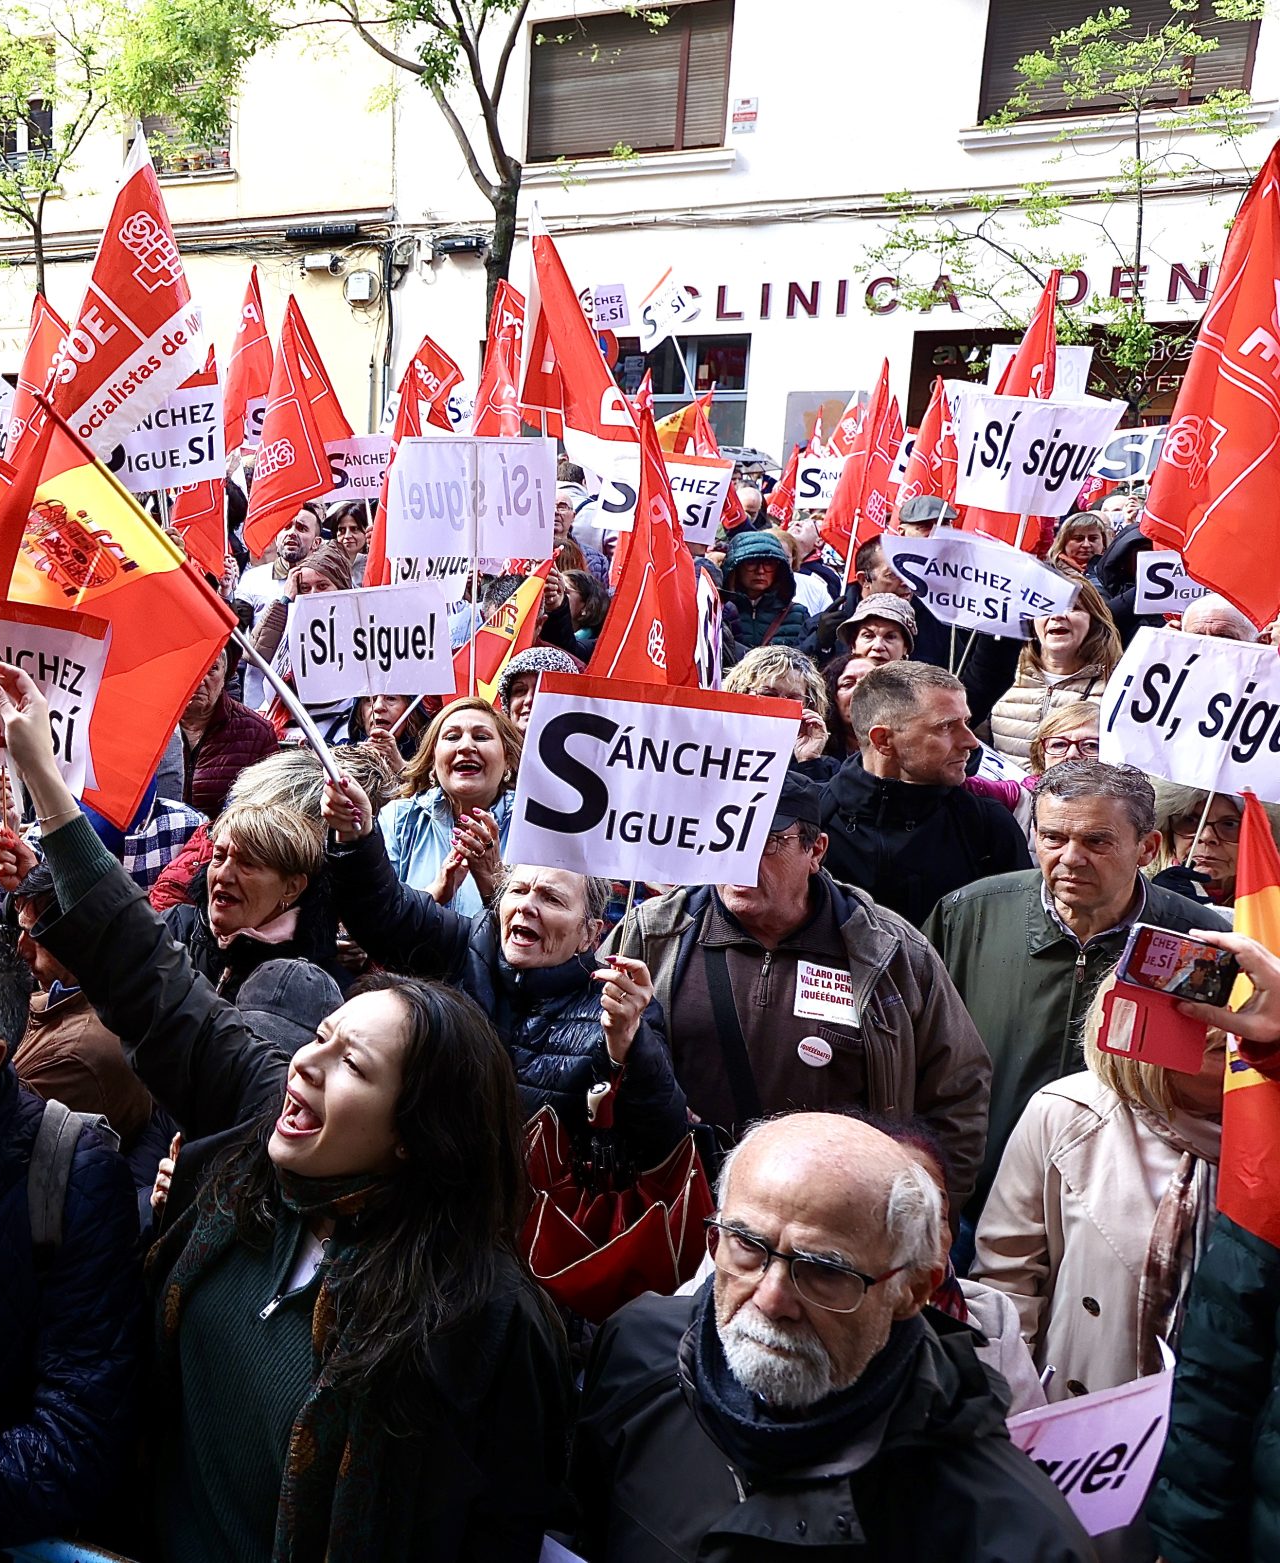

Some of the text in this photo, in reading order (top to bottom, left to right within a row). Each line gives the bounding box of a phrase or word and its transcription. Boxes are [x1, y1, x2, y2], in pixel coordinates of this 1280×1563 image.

[79, 355, 162, 439] ocialistas
[162, 327, 189, 356] de
[414, 358, 442, 394] PSOE
[892, 552, 1013, 599] SÁNCHEZ
[300, 606, 345, 678] ¡SÍ,
[352, 612, 437, 673] sigue!
[1108, 653, 1201, 741] ¡SÍ,
[524, 711, 777, 835] SÁNCHEZ
[800, 975, 819, 988] VALE
[821, 980, 833, 990] LA
[806, 966, 852, 984] CLARO QUE
